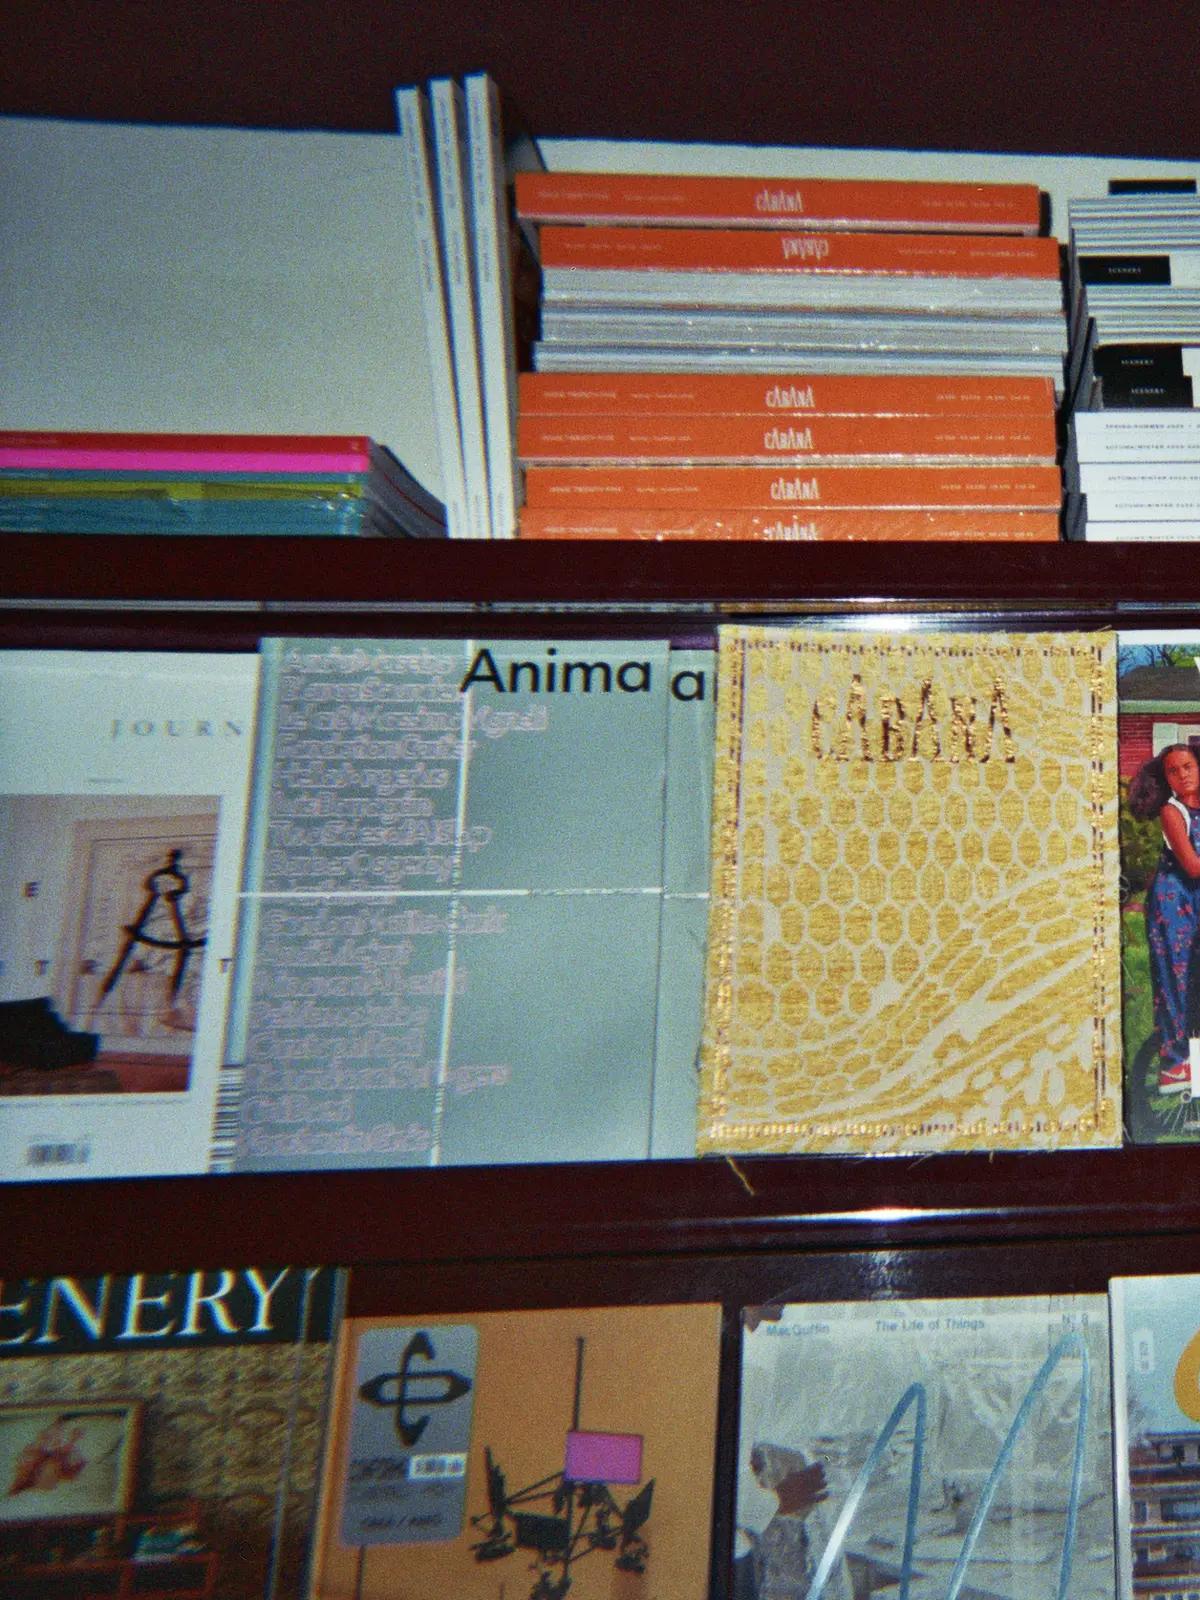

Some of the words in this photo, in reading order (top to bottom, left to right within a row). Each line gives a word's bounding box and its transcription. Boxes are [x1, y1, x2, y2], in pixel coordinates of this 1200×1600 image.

[460, 648, 651, 692] Anima
[810, 673, 1016, 763] CABANA
[876, 1320, 898, 1332] The
[901, 1318, 926, 1332] Life
[929, 1318, 942, 1331] of
[944, 1317, 986, 1333] Things
